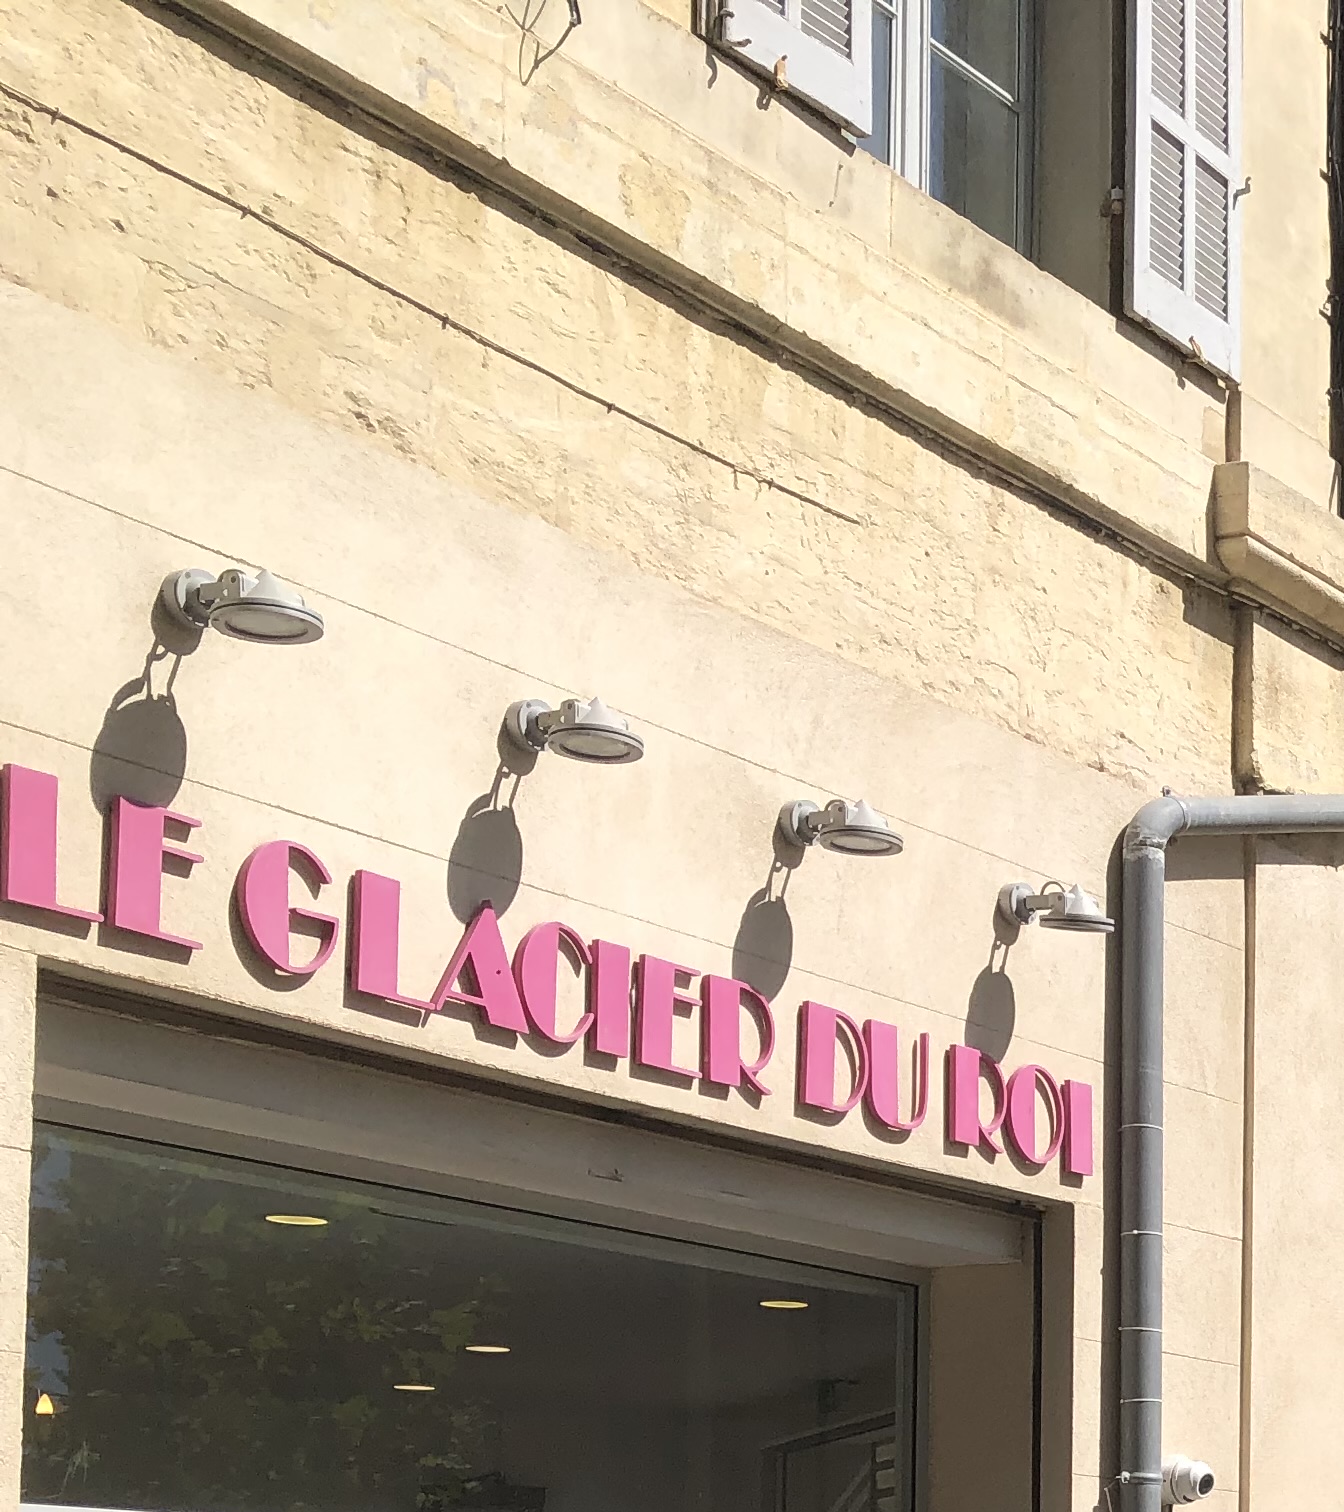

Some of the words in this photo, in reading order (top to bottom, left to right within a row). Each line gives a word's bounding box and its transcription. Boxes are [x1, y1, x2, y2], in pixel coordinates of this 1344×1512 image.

[2, 763, 204, 950] LE
[238, 839, 774, 1096] GLACIER
[802, 1000, 930, 1132] DU
[948, 1044, 1093, 1176] ROI
